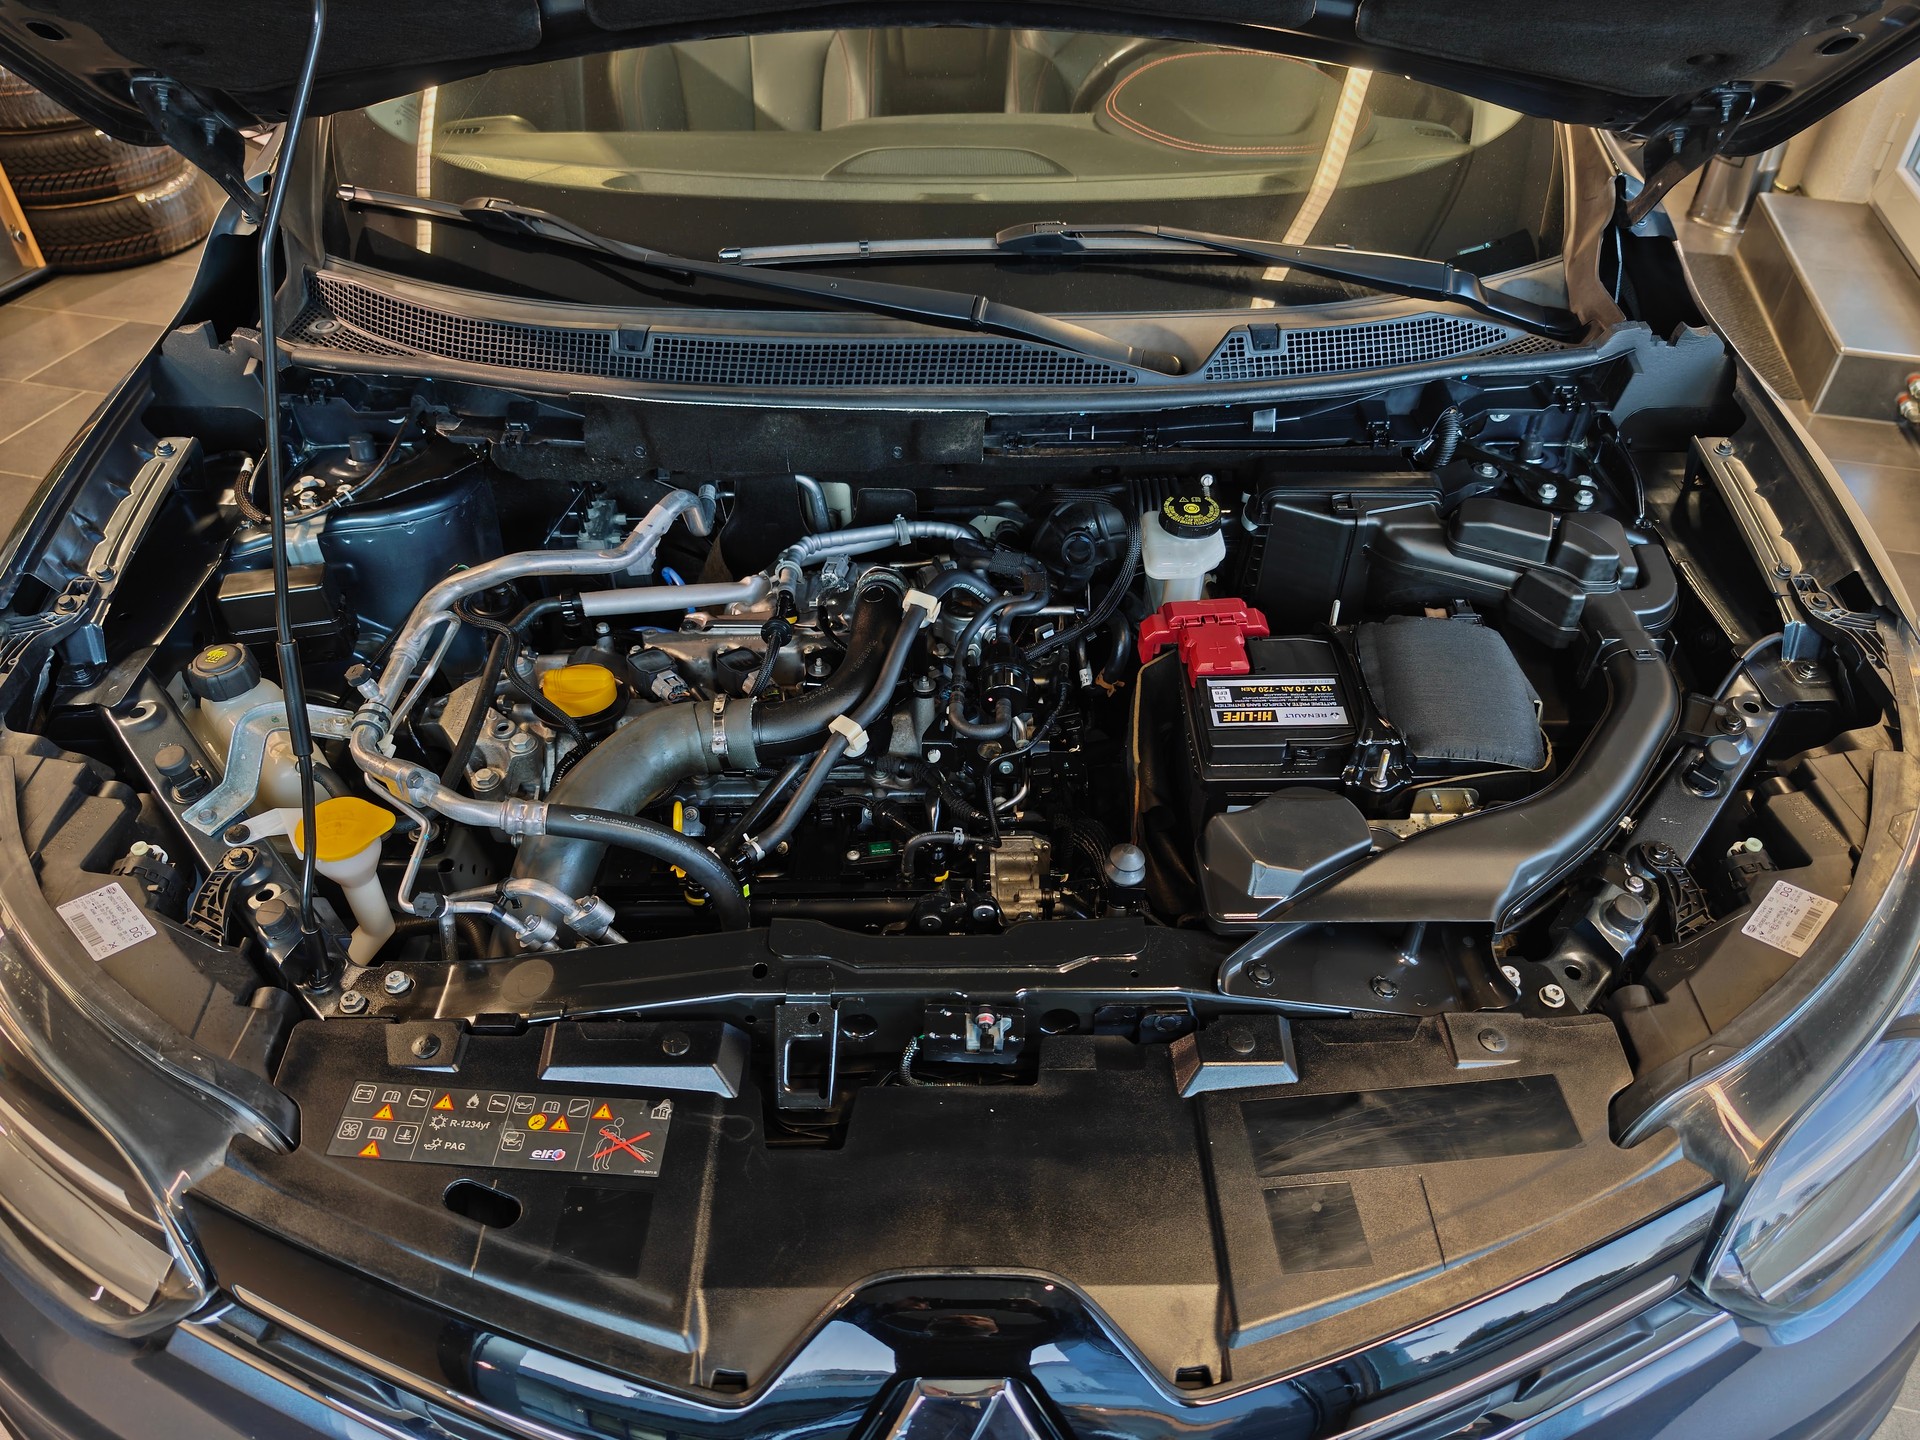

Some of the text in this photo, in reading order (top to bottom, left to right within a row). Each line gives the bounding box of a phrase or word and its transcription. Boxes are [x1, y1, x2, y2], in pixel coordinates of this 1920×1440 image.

[1223, 711, 1272, 722] Hi-LIFE
[449, 1119, 491, 1130] R-1234yf
[444, 1142, 466, 1150] PAG
